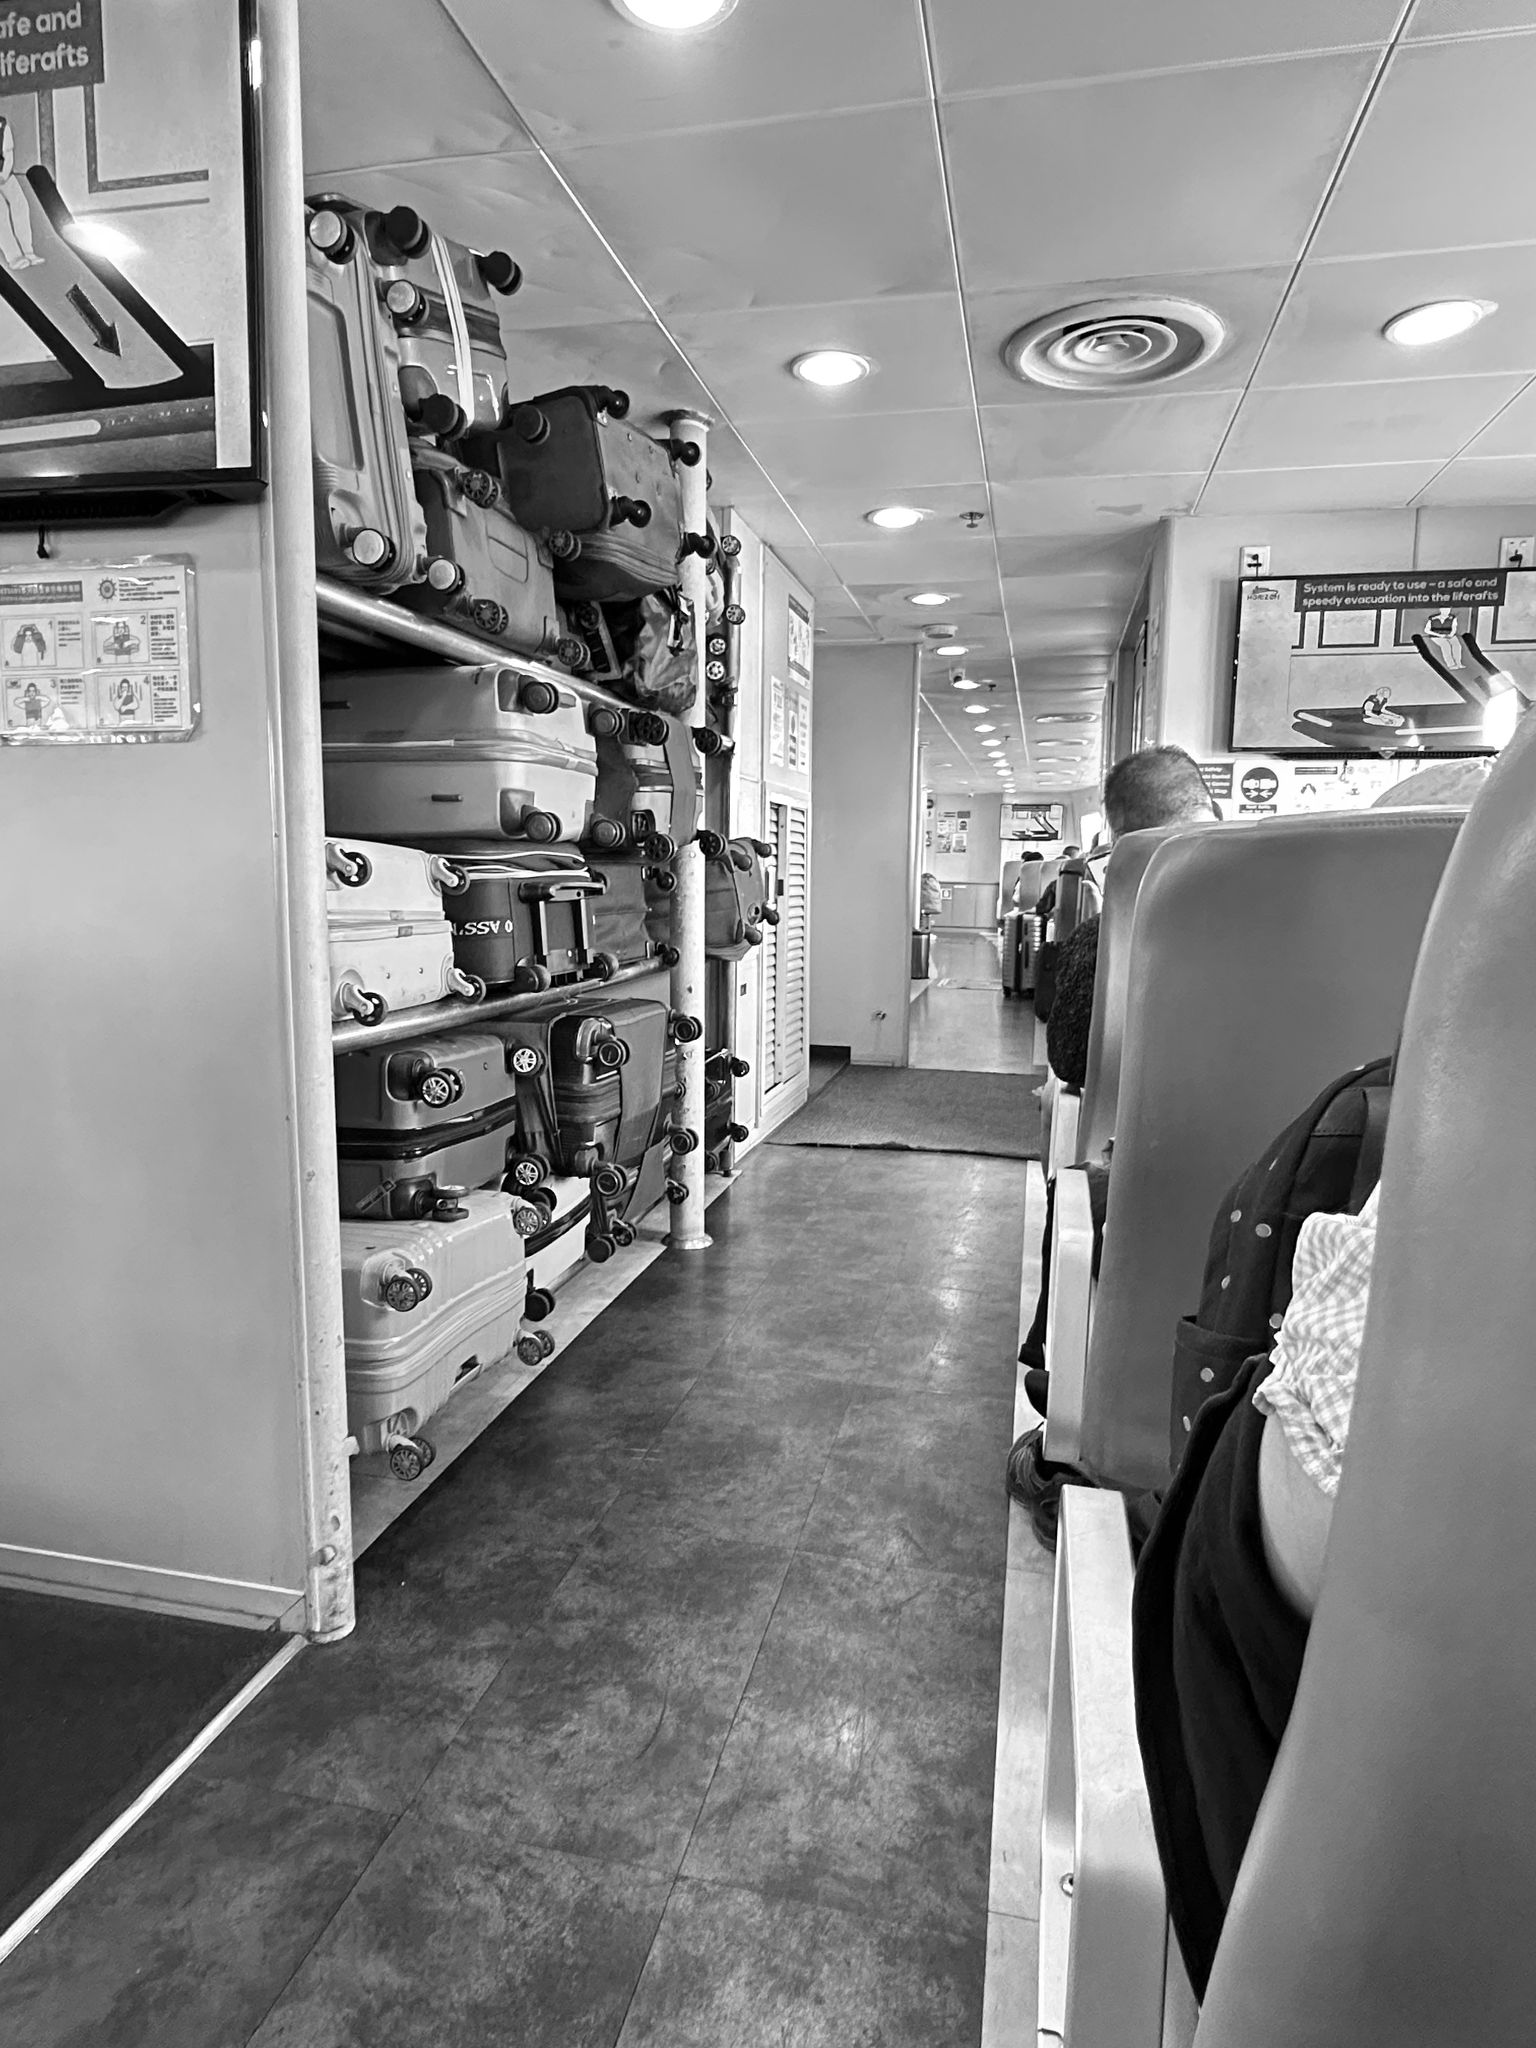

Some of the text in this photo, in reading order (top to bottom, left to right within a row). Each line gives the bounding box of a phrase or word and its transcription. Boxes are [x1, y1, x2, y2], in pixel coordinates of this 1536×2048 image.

[36, 1, 81, 33] and
[1303, 582, 1345, 595] System
[1347, 582, 1356, 592] is
[1357, 580, 1391, 592] ready
[1393, 581, 1405, 590] to
[1407, 581, 1426, 589] use
[1438, 580, 1445, 588] a
[1447, 578, 1473, 588] safe
[1474, 577, 1497, 587] and
[1303, 590, 1499, 607] speedy evacuation into the liferafts
[140, 615, 146, 625] 2
